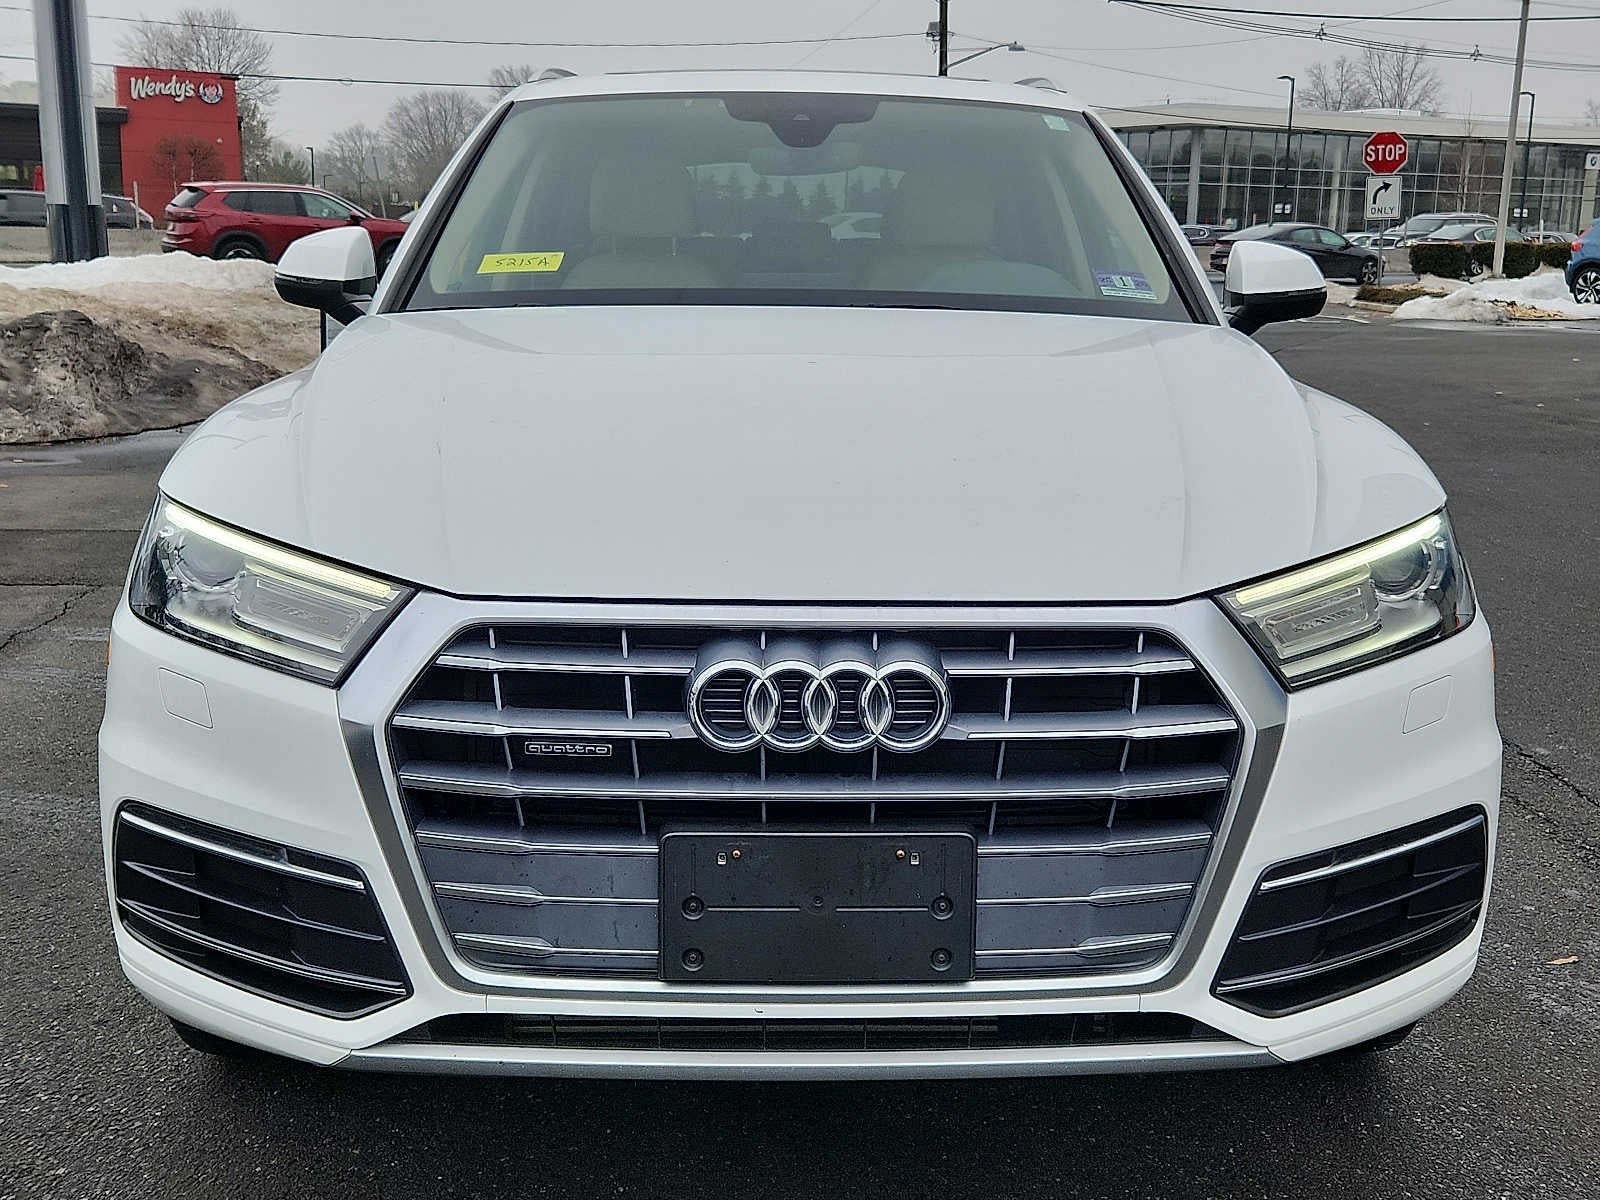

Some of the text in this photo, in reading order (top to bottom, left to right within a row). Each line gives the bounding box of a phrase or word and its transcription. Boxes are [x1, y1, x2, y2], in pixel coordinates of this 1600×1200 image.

[129, 74, 195, 103] Wendy's
[1366, 144, 1405, 162] STOP
[1370, 206, 1395, 215] ONLY
[528, 744, 608, 754] quattro
